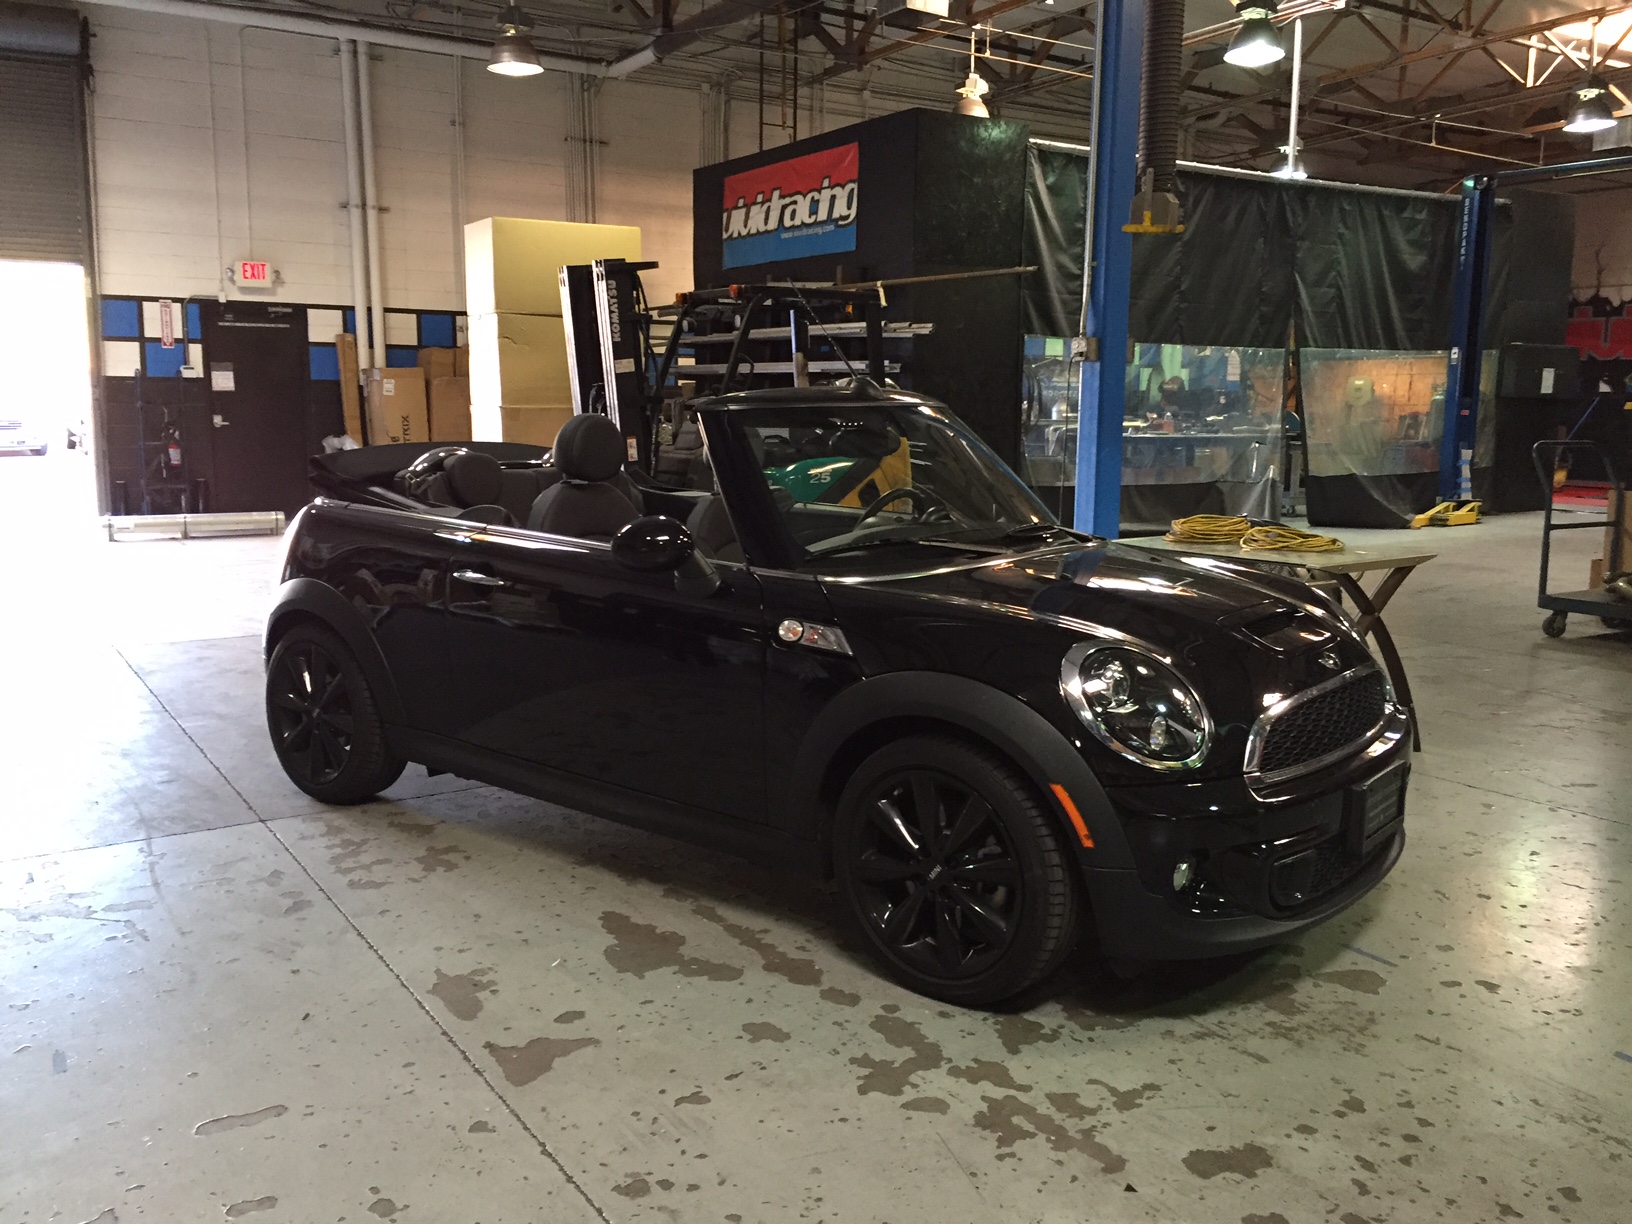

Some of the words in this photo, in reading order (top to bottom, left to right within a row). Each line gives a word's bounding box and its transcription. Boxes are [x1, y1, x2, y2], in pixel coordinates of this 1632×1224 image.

[723, 177, 858, 240] vividracing
[242, 262, 266, 280] EXIT
[607, 279, 622, 342] KOMATSU
[809, 472, 831, 484] 25
